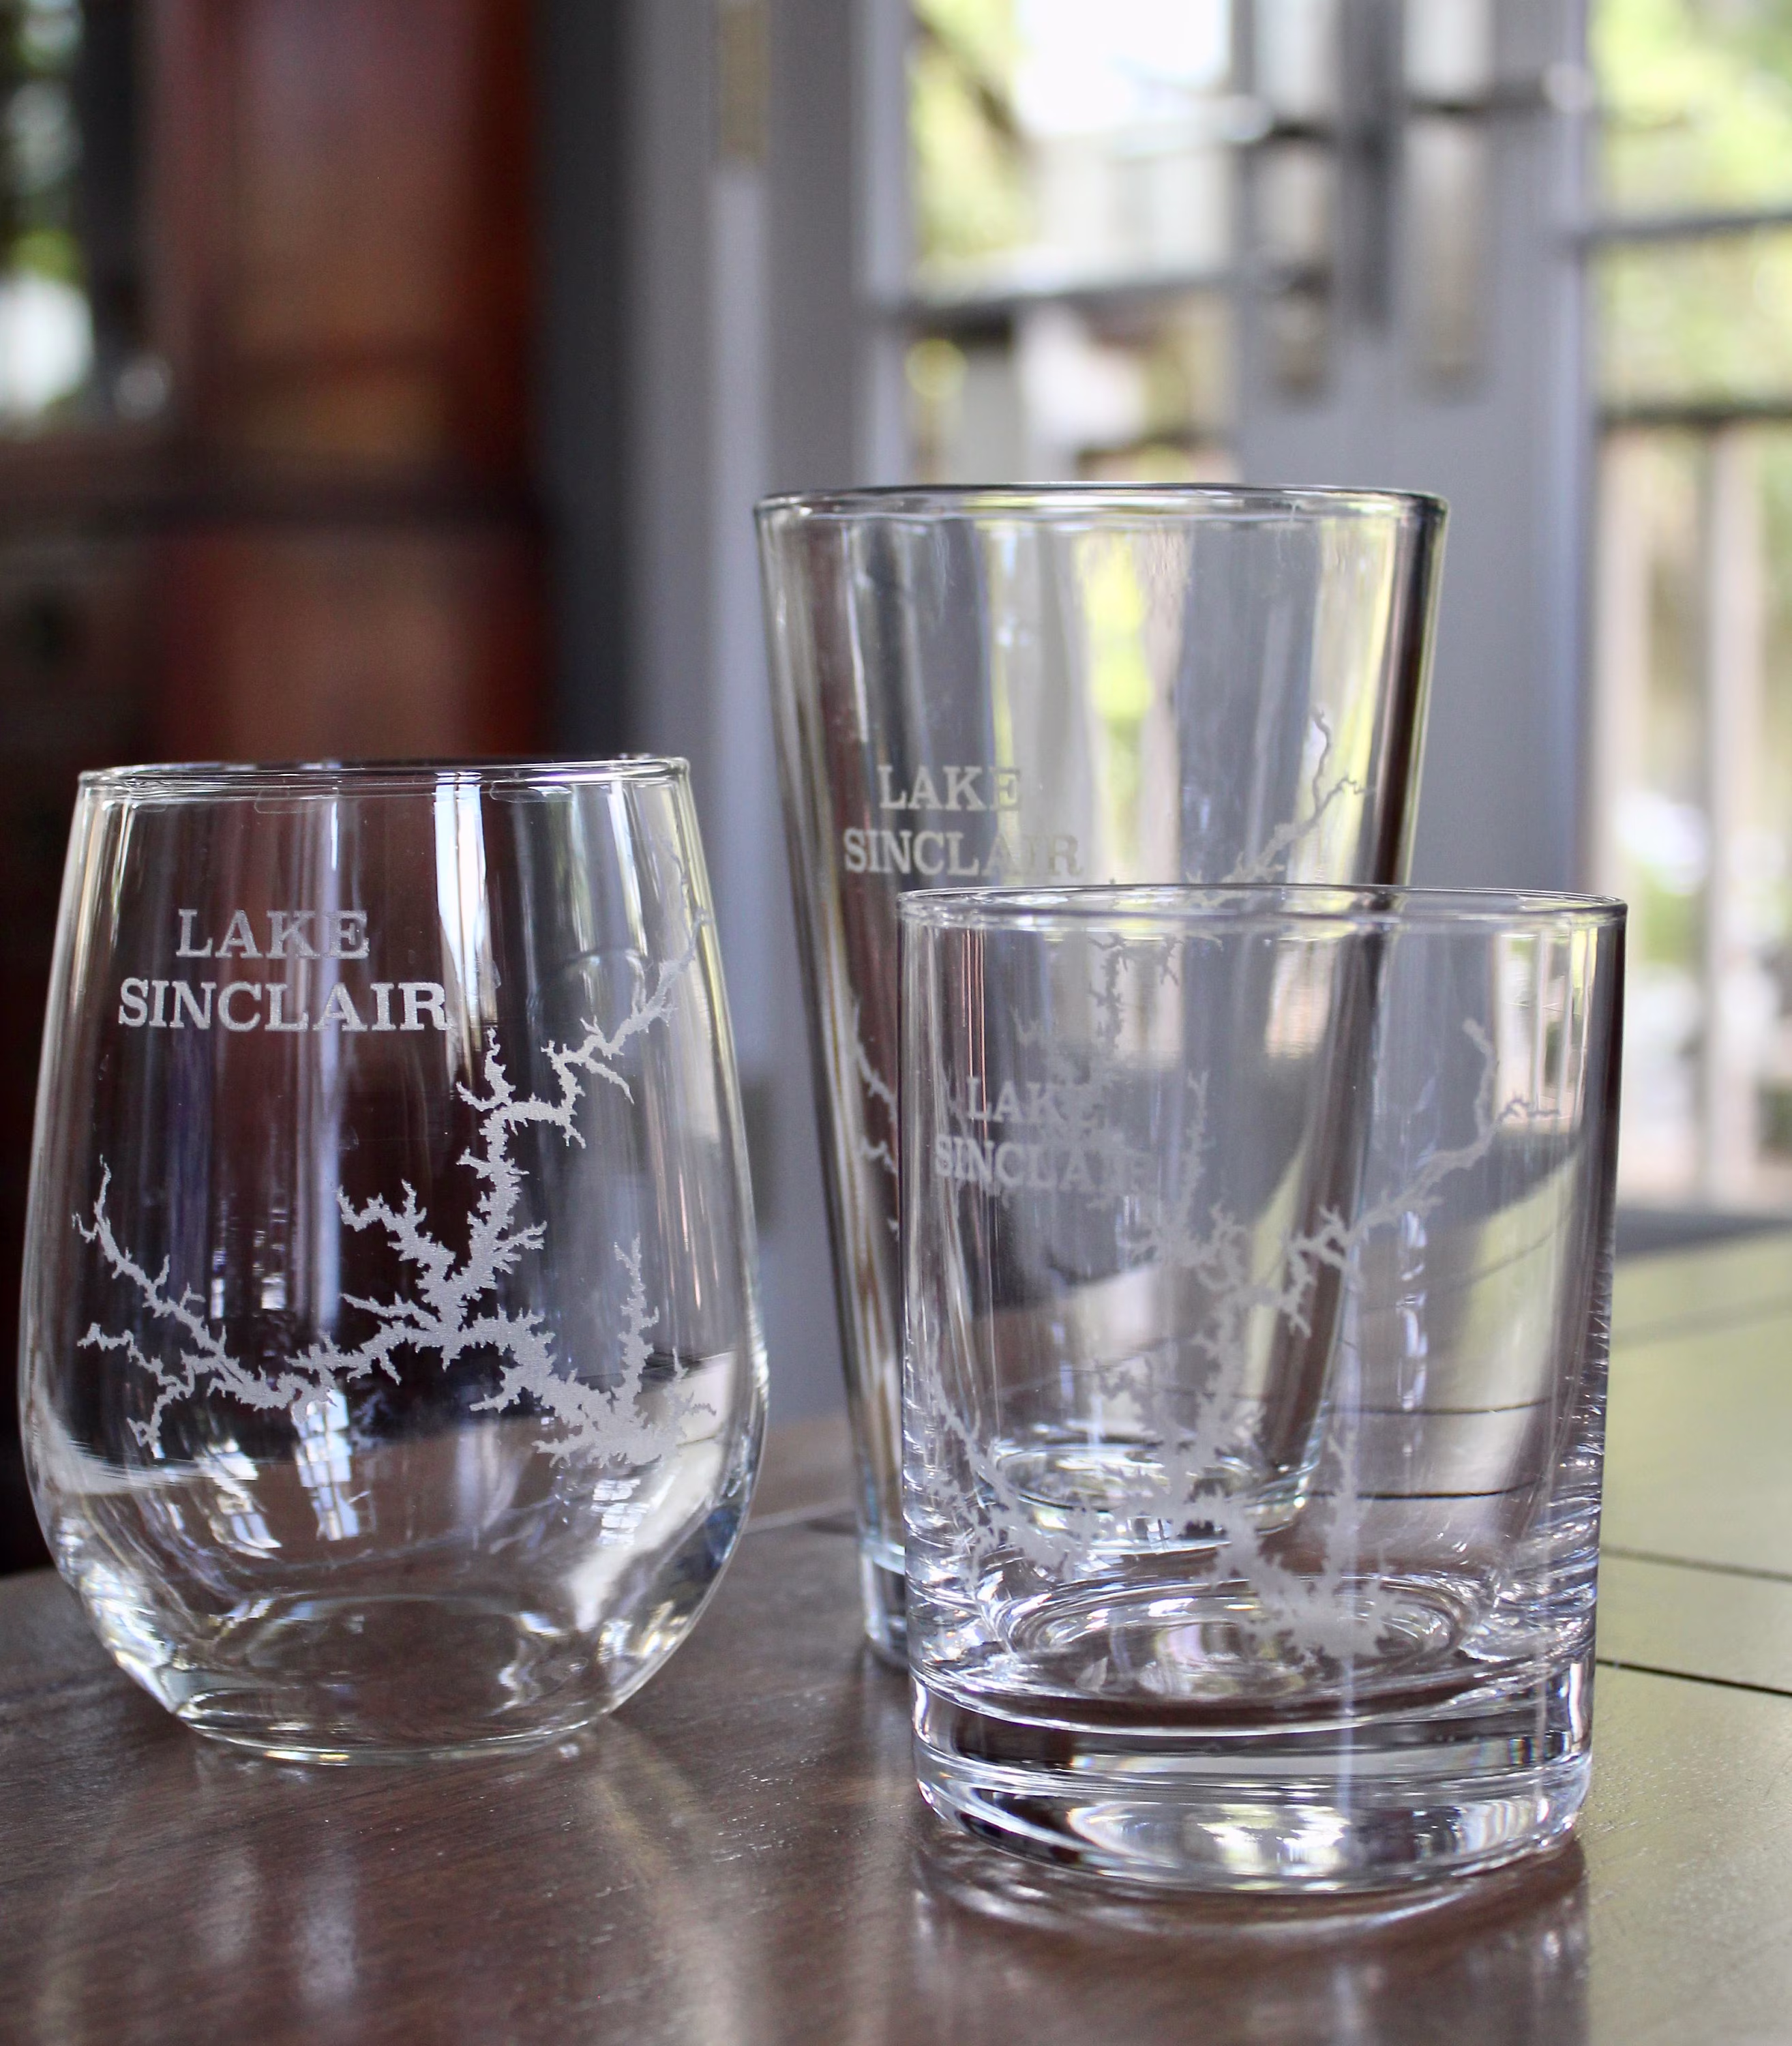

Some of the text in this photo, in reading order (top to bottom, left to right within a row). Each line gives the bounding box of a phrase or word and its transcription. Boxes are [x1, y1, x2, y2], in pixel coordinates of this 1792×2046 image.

[877, 765, 1020, 811] LAKE
[843, 827, 1083, 876] SINCLAIR
[175, 909, 370, 959] LAKE
[118, 977, 453, 1032] SINCLAIR
